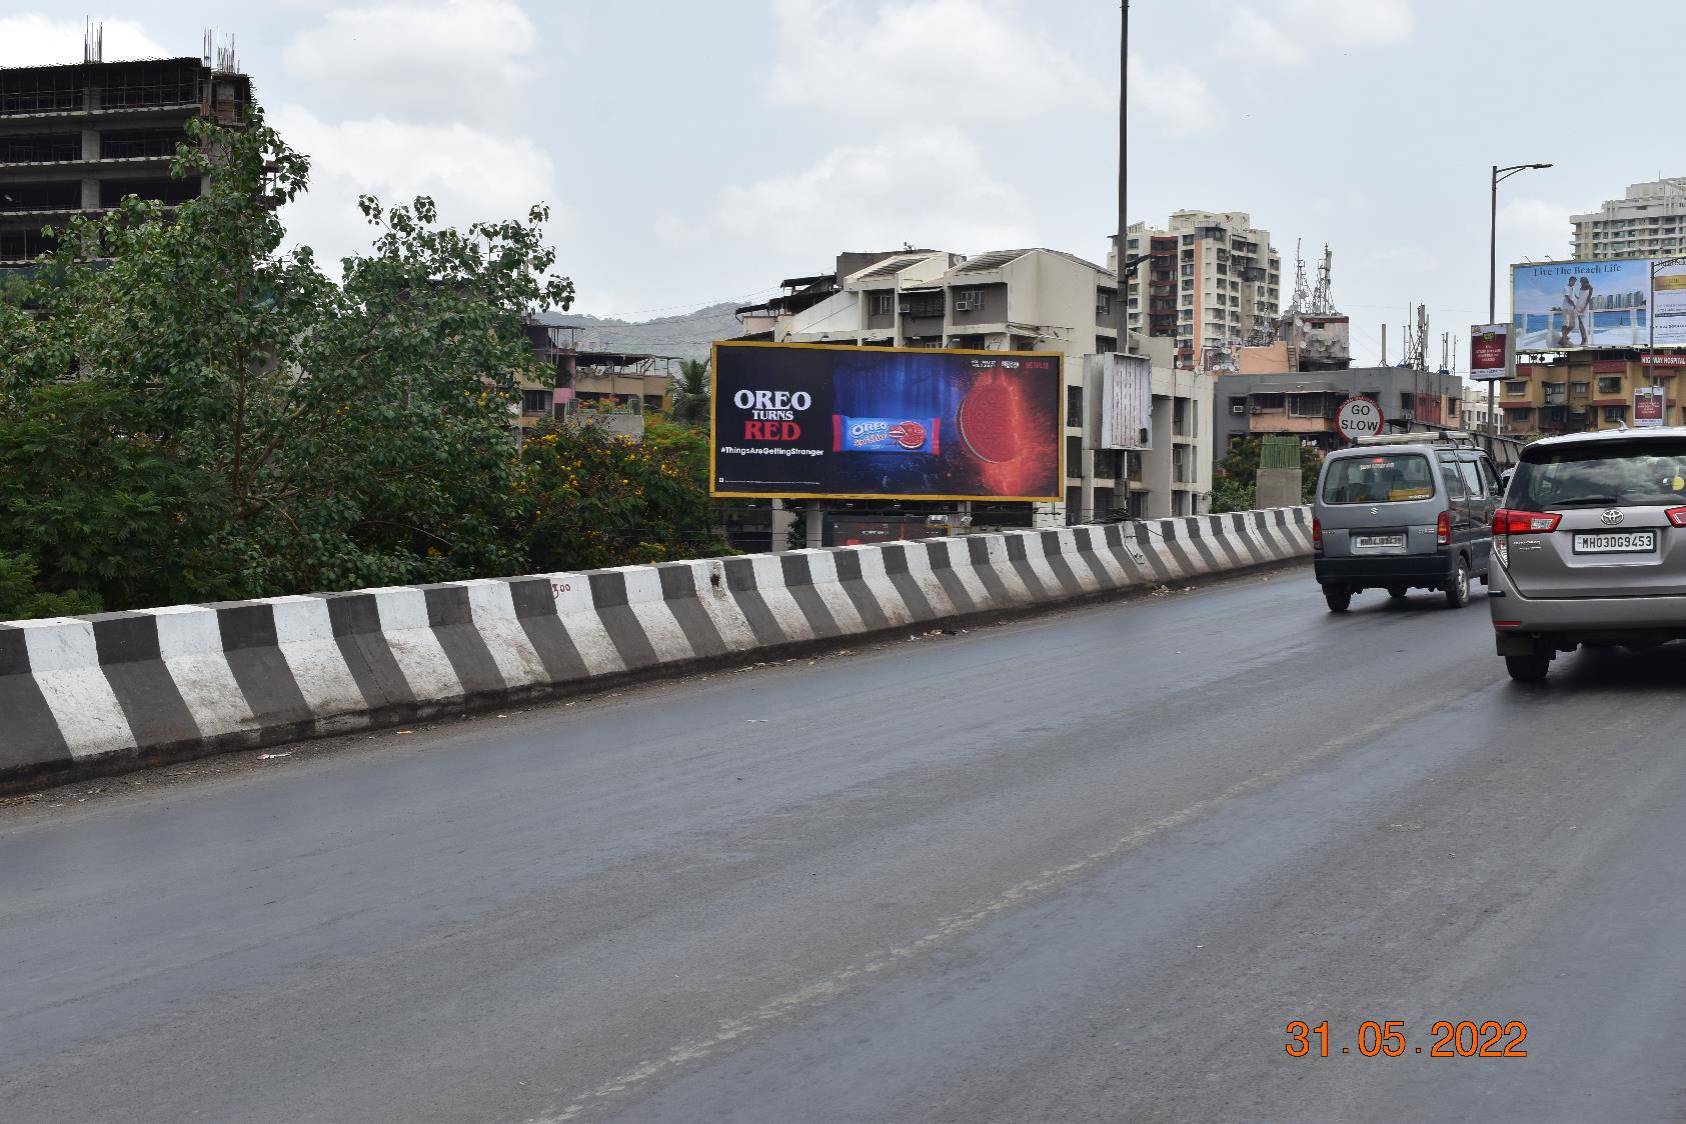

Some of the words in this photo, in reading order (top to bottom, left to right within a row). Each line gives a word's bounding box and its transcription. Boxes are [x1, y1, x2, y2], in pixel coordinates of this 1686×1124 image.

[1534, 268, 1552, 276] Live
[1555, 266, 1571, 275] The
[1574, 265, 1600, 274] Beach
[1604, 263, 1621, 272] Life
[734, 389, 812, 411] OREO
[751, 410, 794, 420] TURNS
[1351, 404, 1370, 416] GO
[743, 420, 801, 441] RED
[852, 421, 887, 436] OREO
[1341, 419, 1378, 431] SLOW
[720, 446, 825, 457] #ThingsAreGettingStranger
[1581, 535, 1652, 549] MH03DG9453
